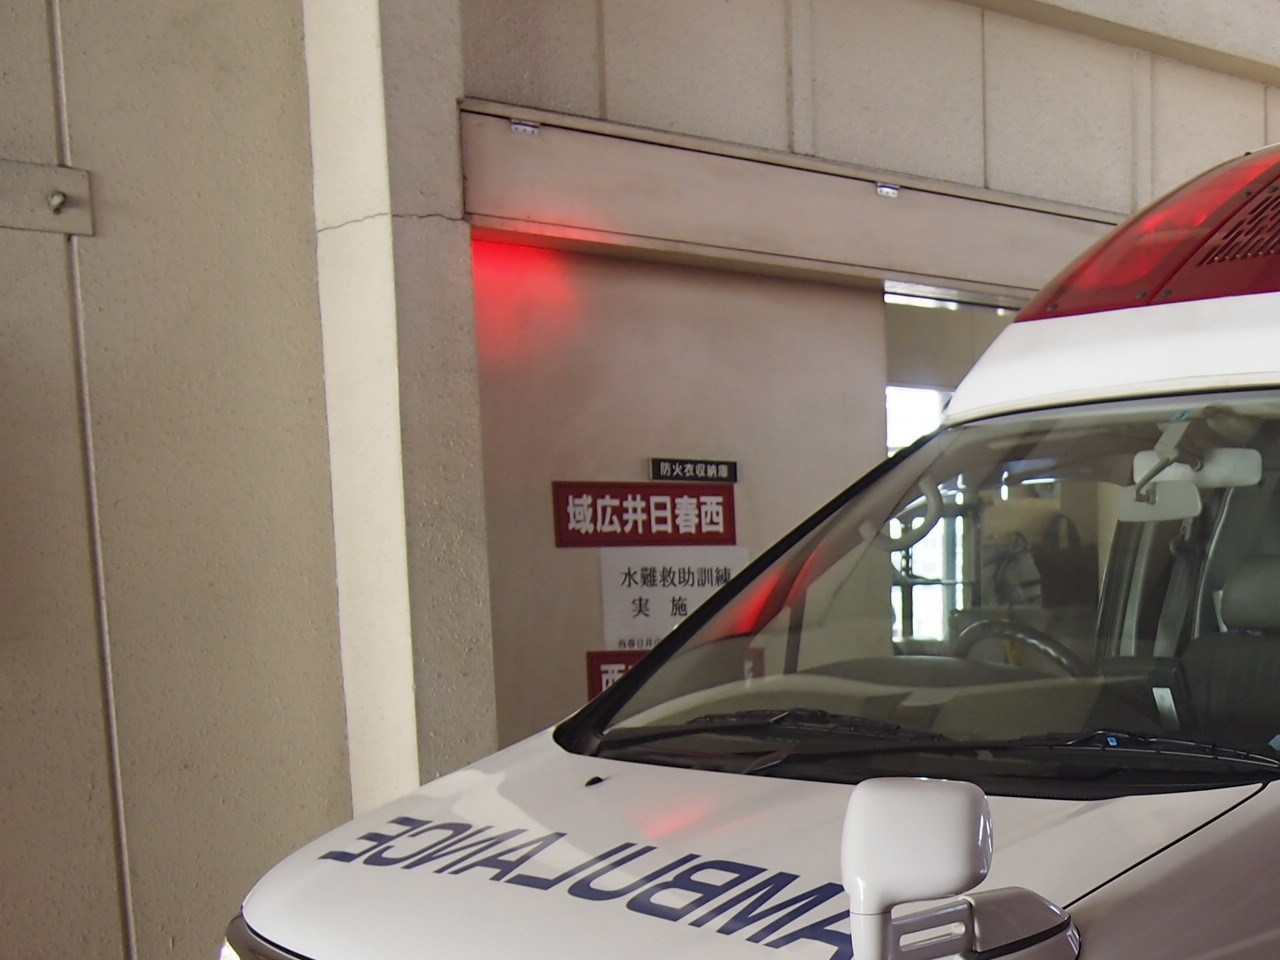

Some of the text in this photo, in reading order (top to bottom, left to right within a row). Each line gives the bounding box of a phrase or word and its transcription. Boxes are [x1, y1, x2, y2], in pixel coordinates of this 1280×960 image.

[659, 462, 729, 479] 防火衣収納庫
[620, 566, 732, 588] 水難救助訓練
